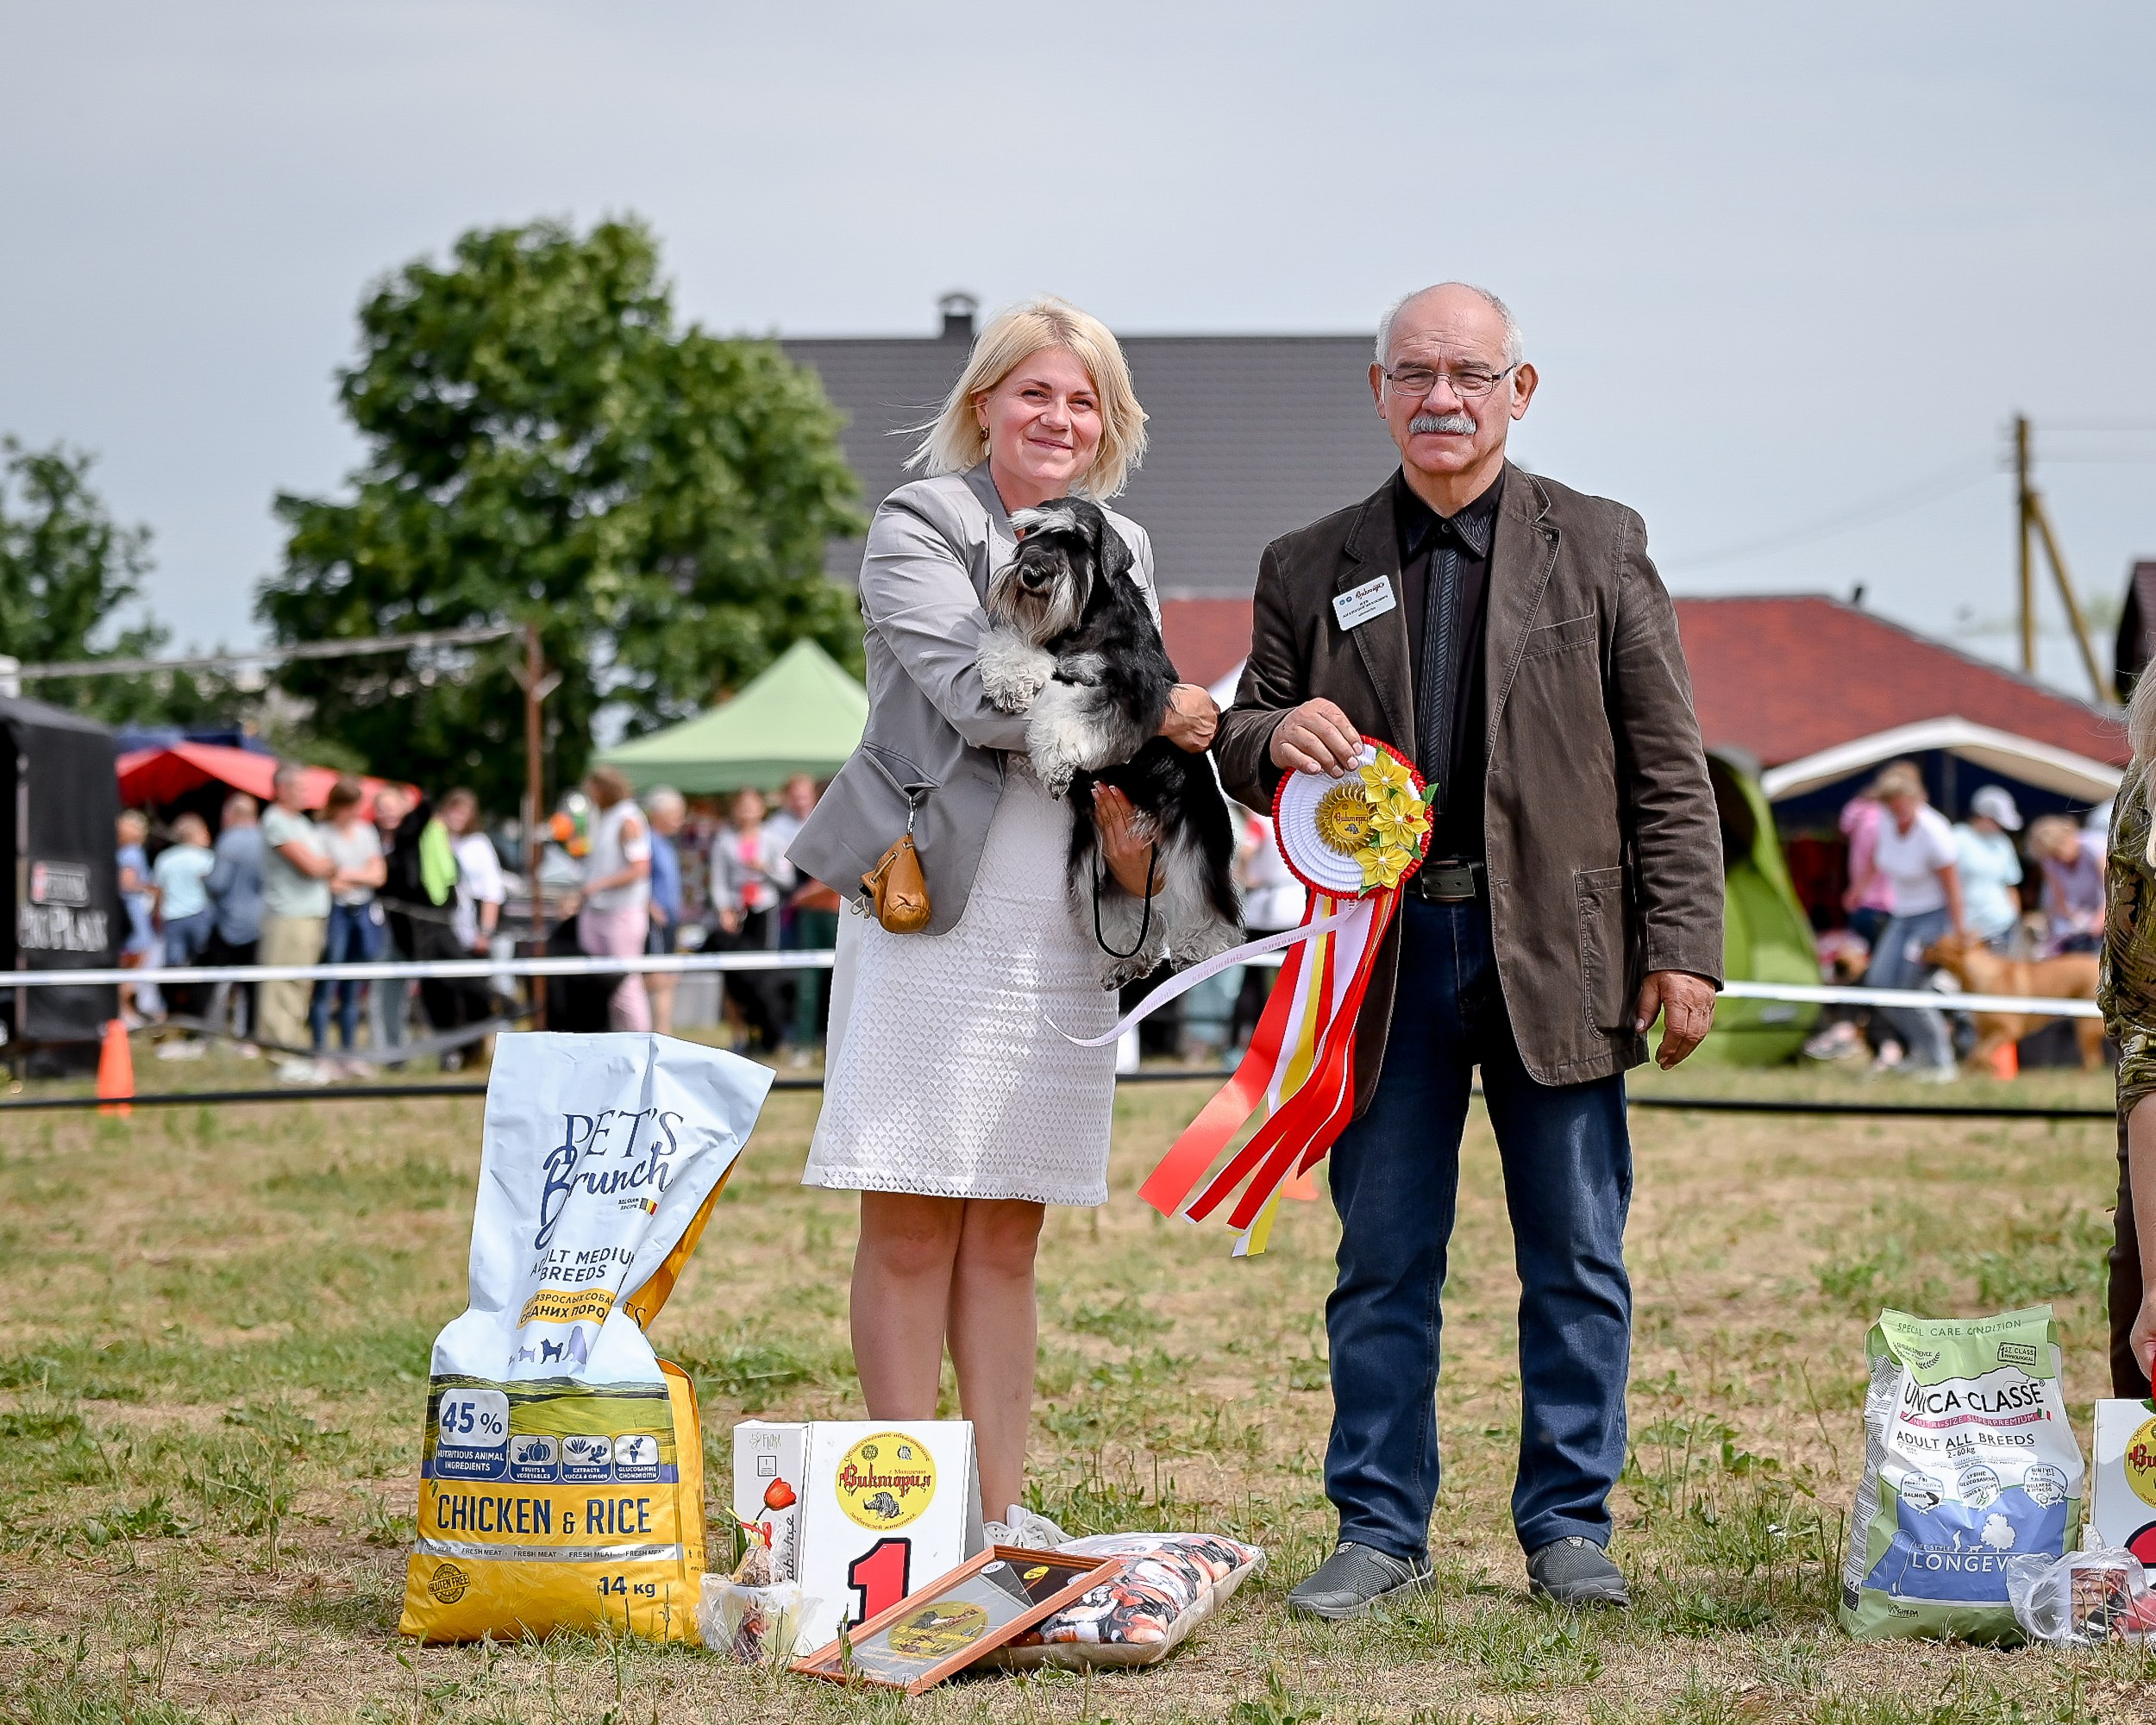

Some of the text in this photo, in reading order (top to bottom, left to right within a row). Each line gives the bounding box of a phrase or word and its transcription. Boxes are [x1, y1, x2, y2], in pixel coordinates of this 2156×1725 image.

[562, 1107, 684, 1165] PET'S
[534, 1141, 674, 1251] Brunch
[539, 1264, 607, 1282] BREEDS
[571, 1305, 609, 1322] ПОРО
[1897, 1319, 2021, 1337] SPECIAL CARE CONDITION
[1904, 1382, 1961, 1414] UNICA
[442, 1402, 503, 1435] 45 %
[1966, 1413, 2035, 1427] SUPERPREMIUM
[1896, 1430, 1940, 1450] ADULT
[1946, 1433, 1972, 1450] ALL
[1978, 1432, 2035, 1446] BREEDS
[437, 1450, 505, 1462] NUTRITIOUS ANIMAL
[445, 1460, 491, 1471] INGREDIENTS
[437, 1495, 652, 1534] CHICKEN & RICE
[1912, 1552, 2010, 1572] LONGEV
[429, 1574, 468, 1592] GLUTEN FREE
[599, 1576, 627, 1596] 14
[847, 1538, 912, 1633] 1
